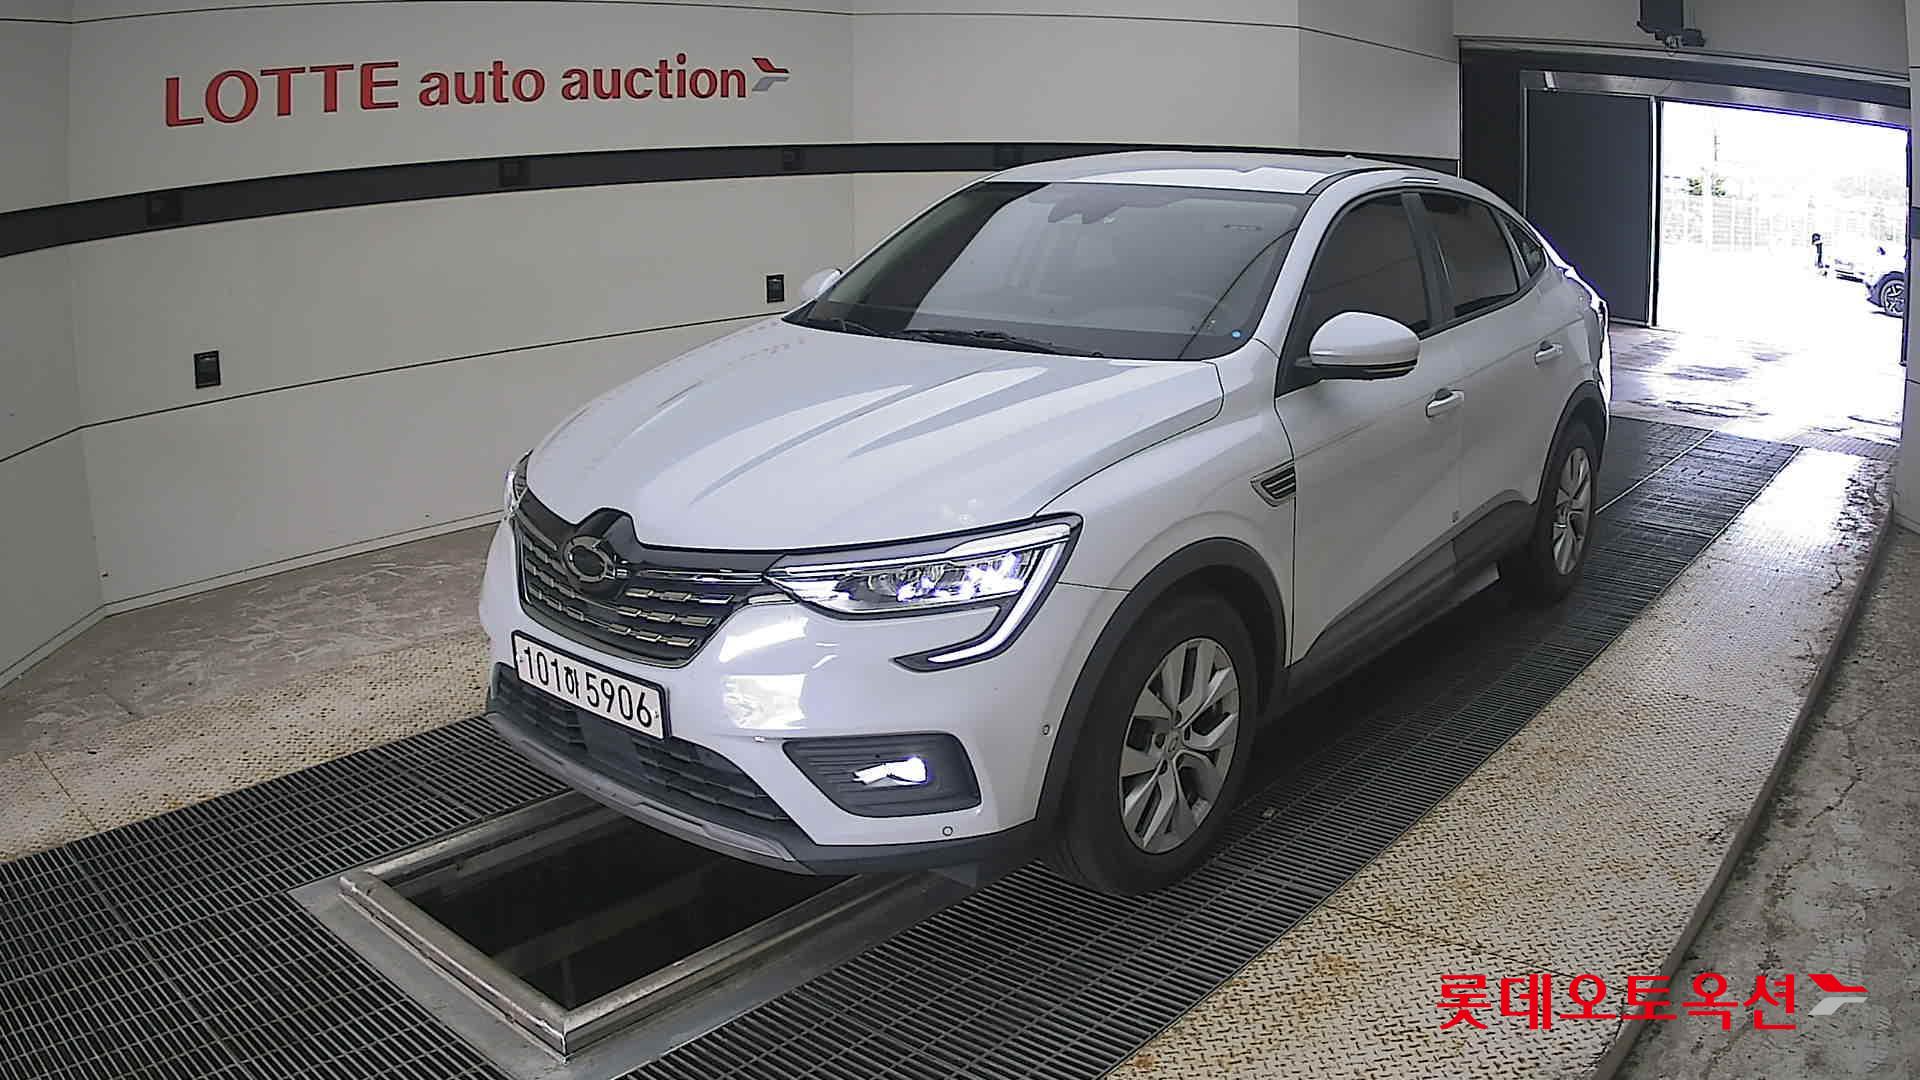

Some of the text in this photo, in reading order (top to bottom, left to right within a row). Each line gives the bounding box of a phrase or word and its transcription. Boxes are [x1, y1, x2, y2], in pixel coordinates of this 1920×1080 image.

[165, 52, 747, 127] LOTTE auto auction
[585, 671, 652, 728] 5906
